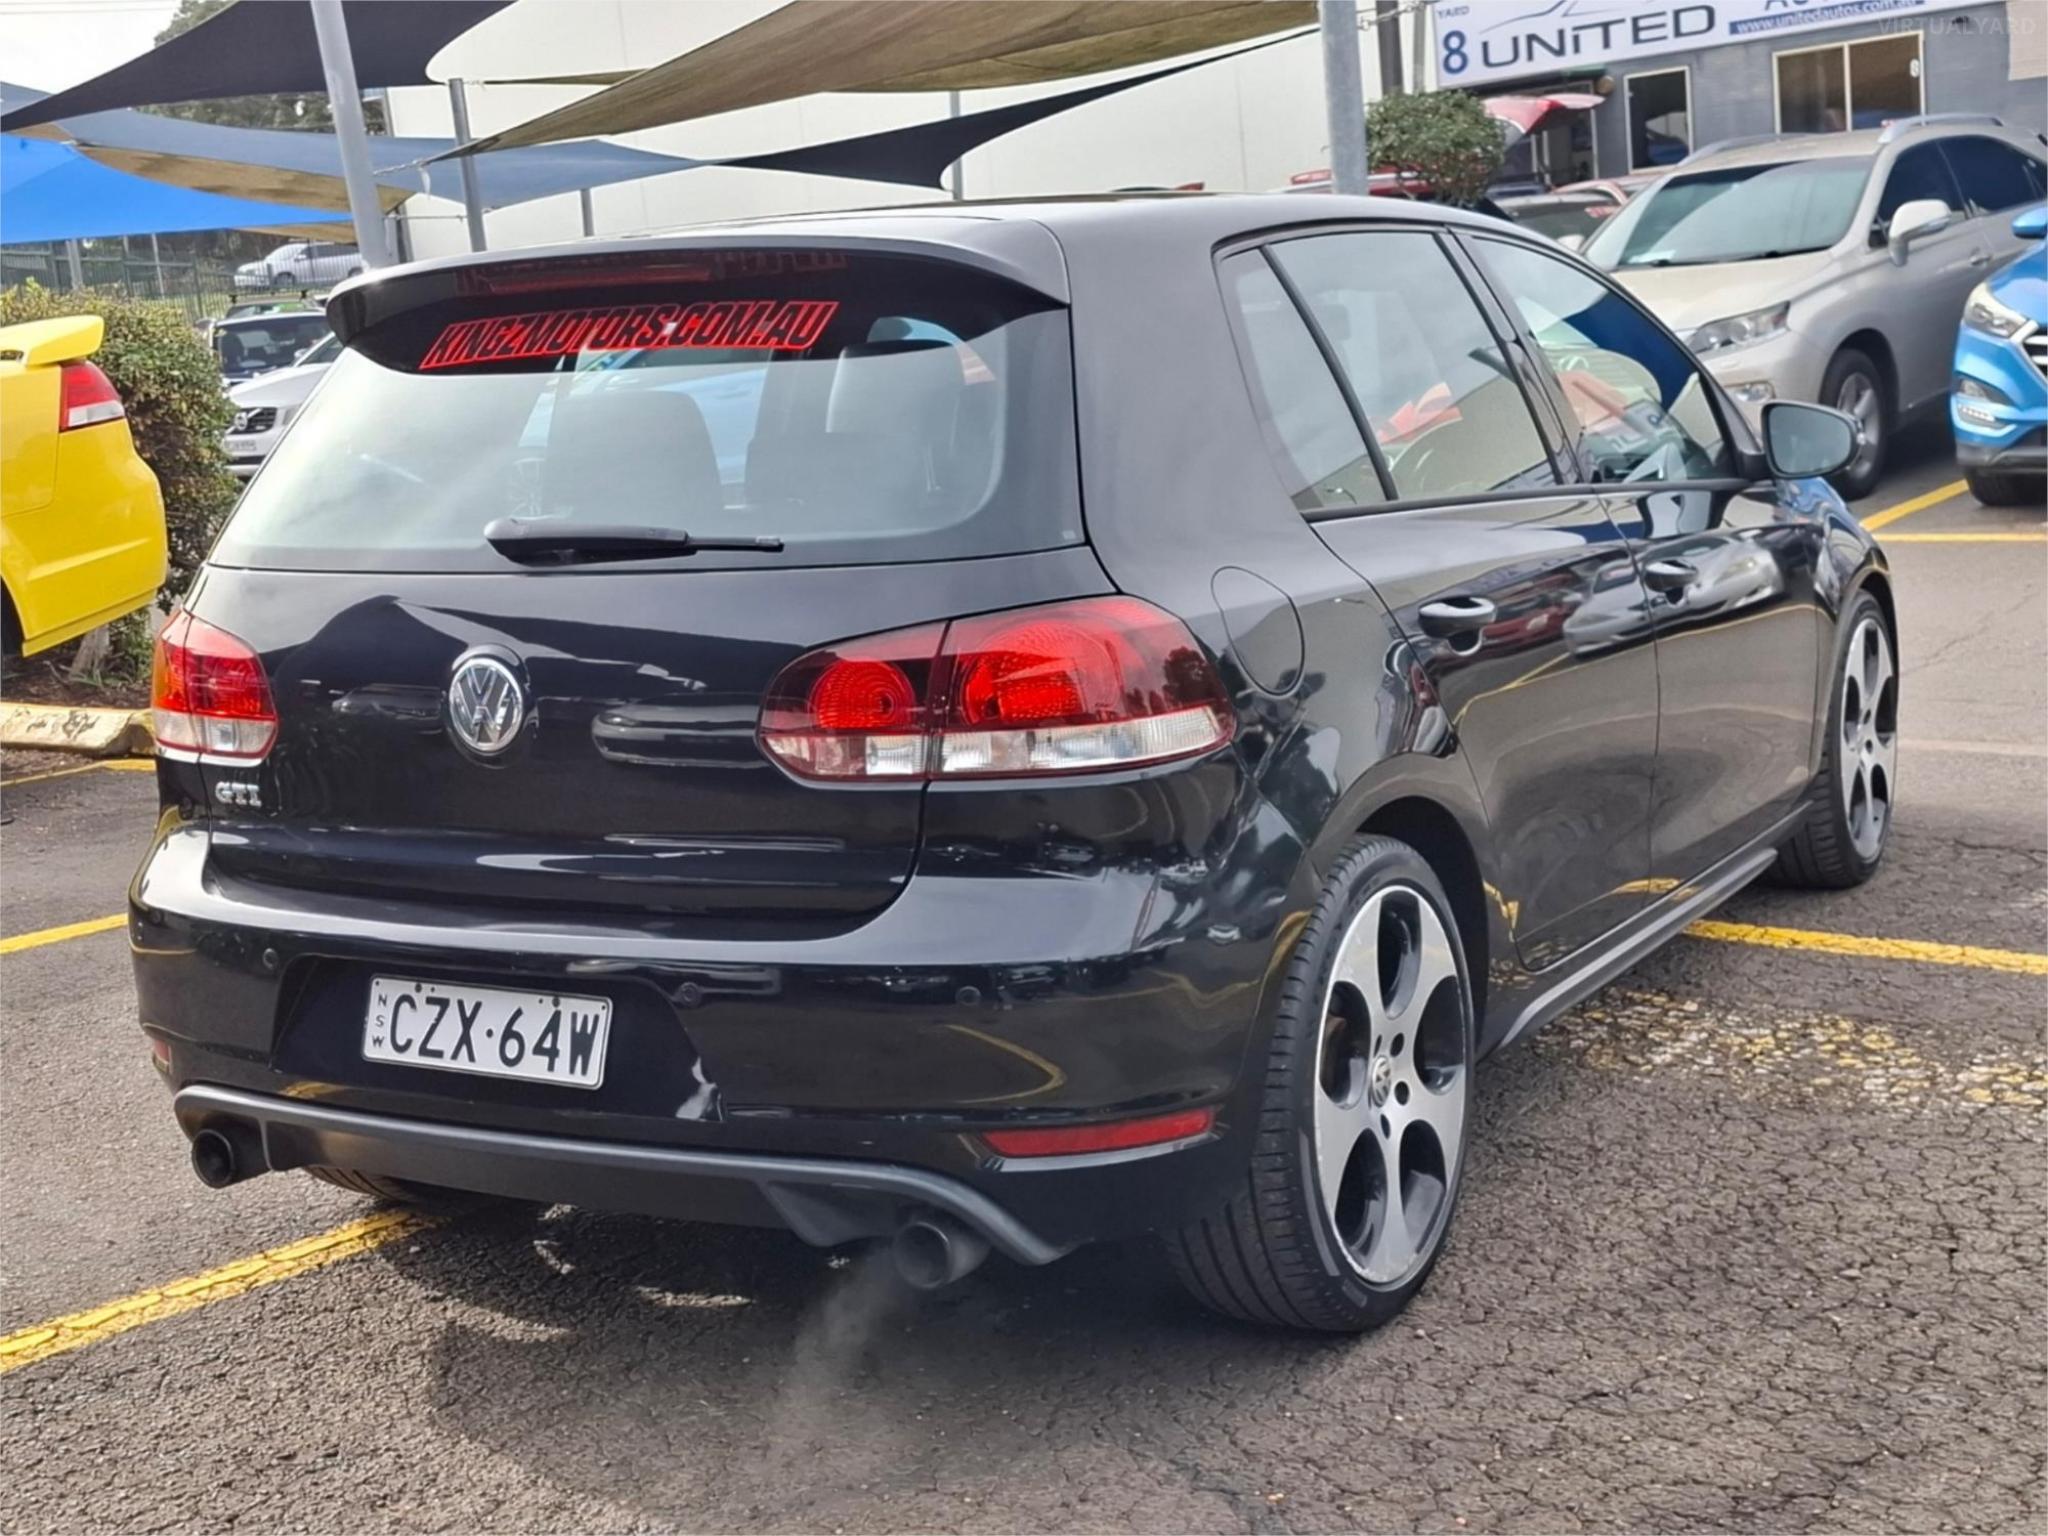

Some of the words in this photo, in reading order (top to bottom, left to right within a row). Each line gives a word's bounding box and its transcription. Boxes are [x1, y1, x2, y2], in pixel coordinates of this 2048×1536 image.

[1443, 30, 1468, 75] 8
[1481, 4, 1716, 69] UNITED
[215, 781, 262, 807] GTI
